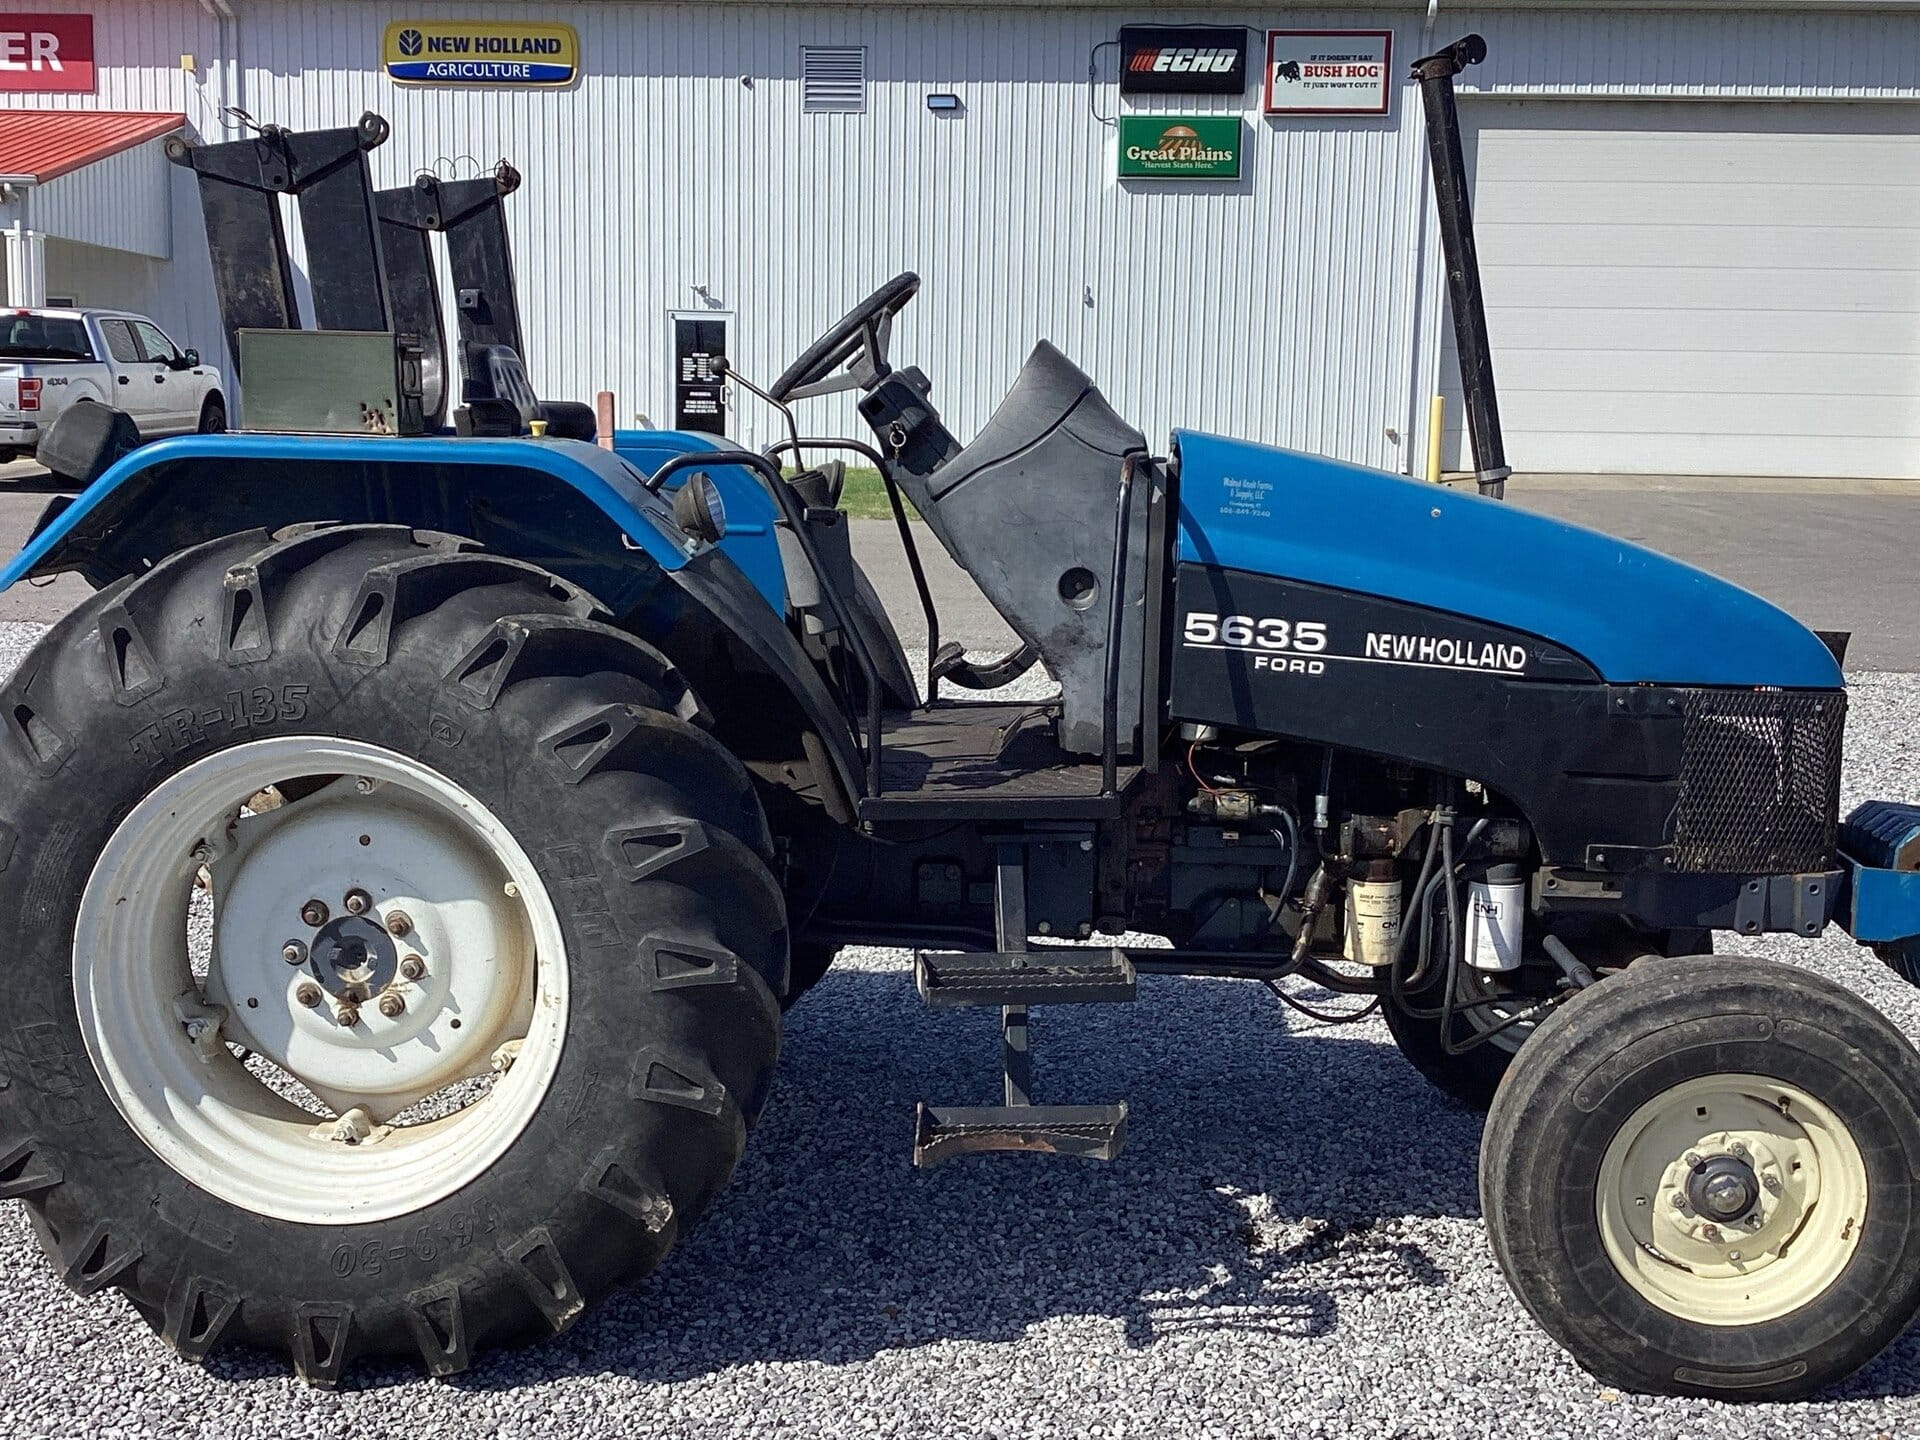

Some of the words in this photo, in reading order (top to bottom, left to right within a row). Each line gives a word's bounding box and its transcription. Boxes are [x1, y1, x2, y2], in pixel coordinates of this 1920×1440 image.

[428, 36, 470, 53] NEW
[475, 37, 562, 54] HOLLAND
[1152, 48, 1238, 73] ECHO
[426, 63, 531, 78] AGRICULTURE
[1303, 65, 1343, 78] BUSH
[1345, 65, 1379, 78] HOG
[1311, 82, 1328, 90] JUST
[1126, 145, 1177, 161] Great
[1179, 146, 1233, 161] Plains
[1173, 161, 1193, 169] Starts
[1183, 612, 1328, 652] 5635
[1254, 656, 1326, 675] FORD
[128, 683, 310, 767] TR-135
